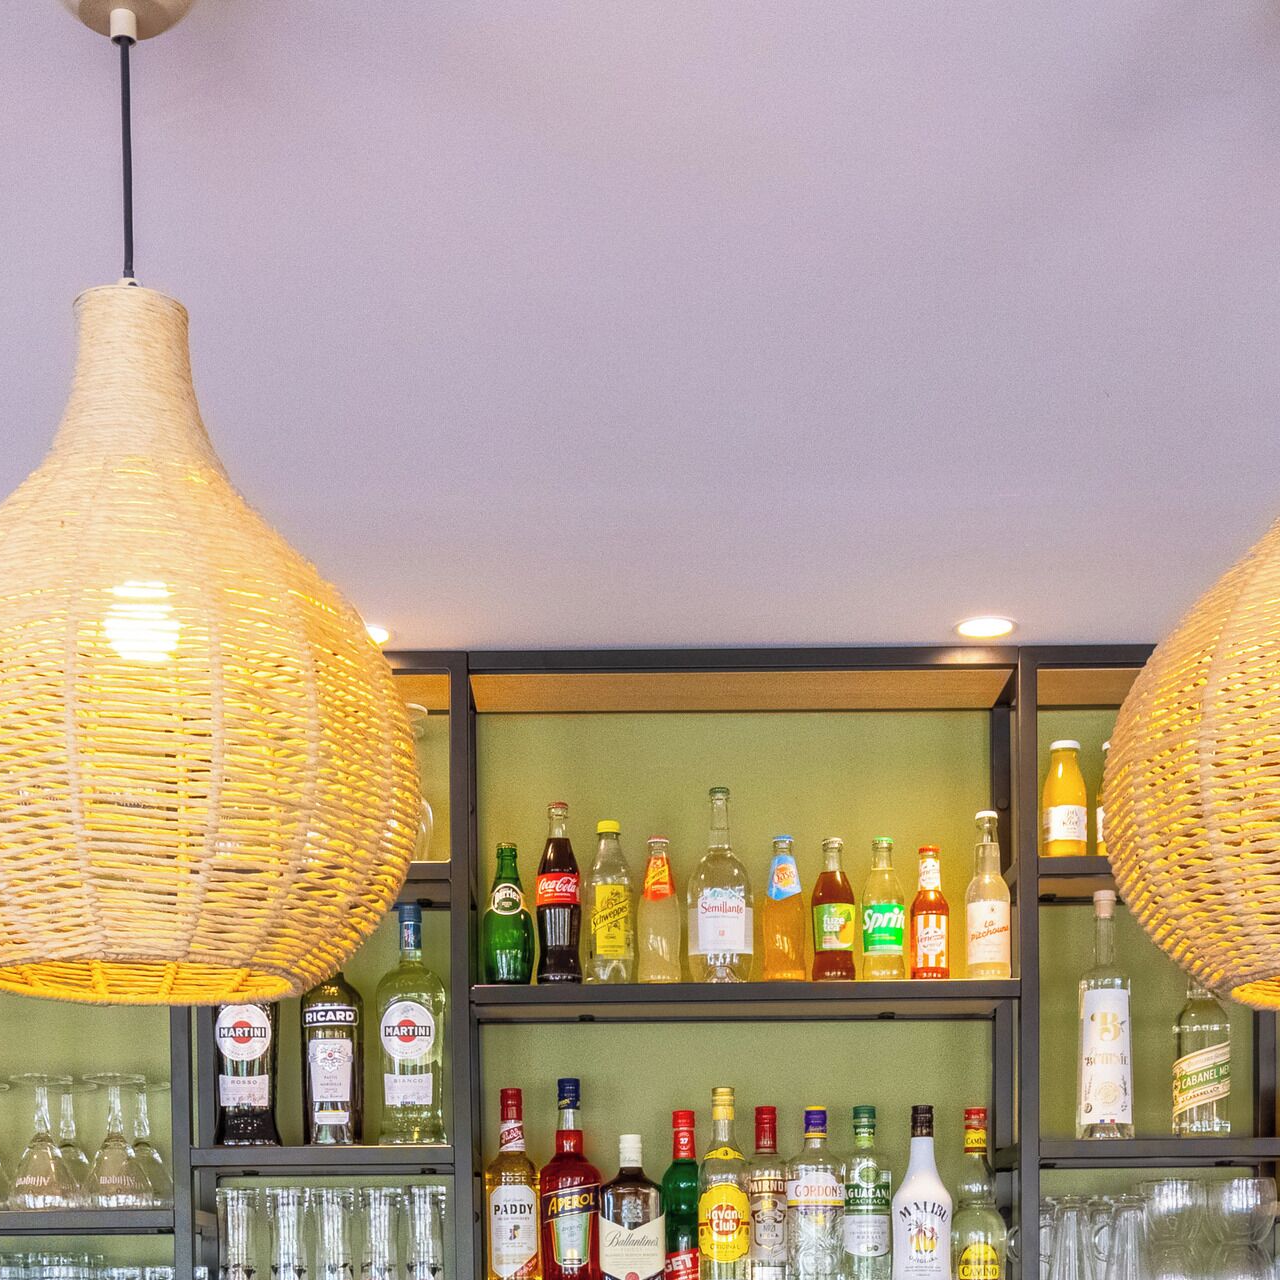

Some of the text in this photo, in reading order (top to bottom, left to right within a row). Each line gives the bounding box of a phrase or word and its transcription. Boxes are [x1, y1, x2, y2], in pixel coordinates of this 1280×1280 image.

[701, 901, 744, 914] Sémillante
[593, 904, 629, 928] Schweppes
[305, 1011, 355, 1023] RICARD
[220, 1027, 265, 1038] MARTINI
[385, 1026, 430, 1036] MARTINI
[1181, 1068, 1217, 1089] CABANEL
[493, 1204, 534, 1216] PADDY
[548, 1193, 595, 1216] APEROL
[706, 1207, 745, 1221] Havana
[899, 1201, 949, 1222] MALIBU
[712, 1218, 738, 1231] Club
[962, 1265, 998, 1276] CAMINO
